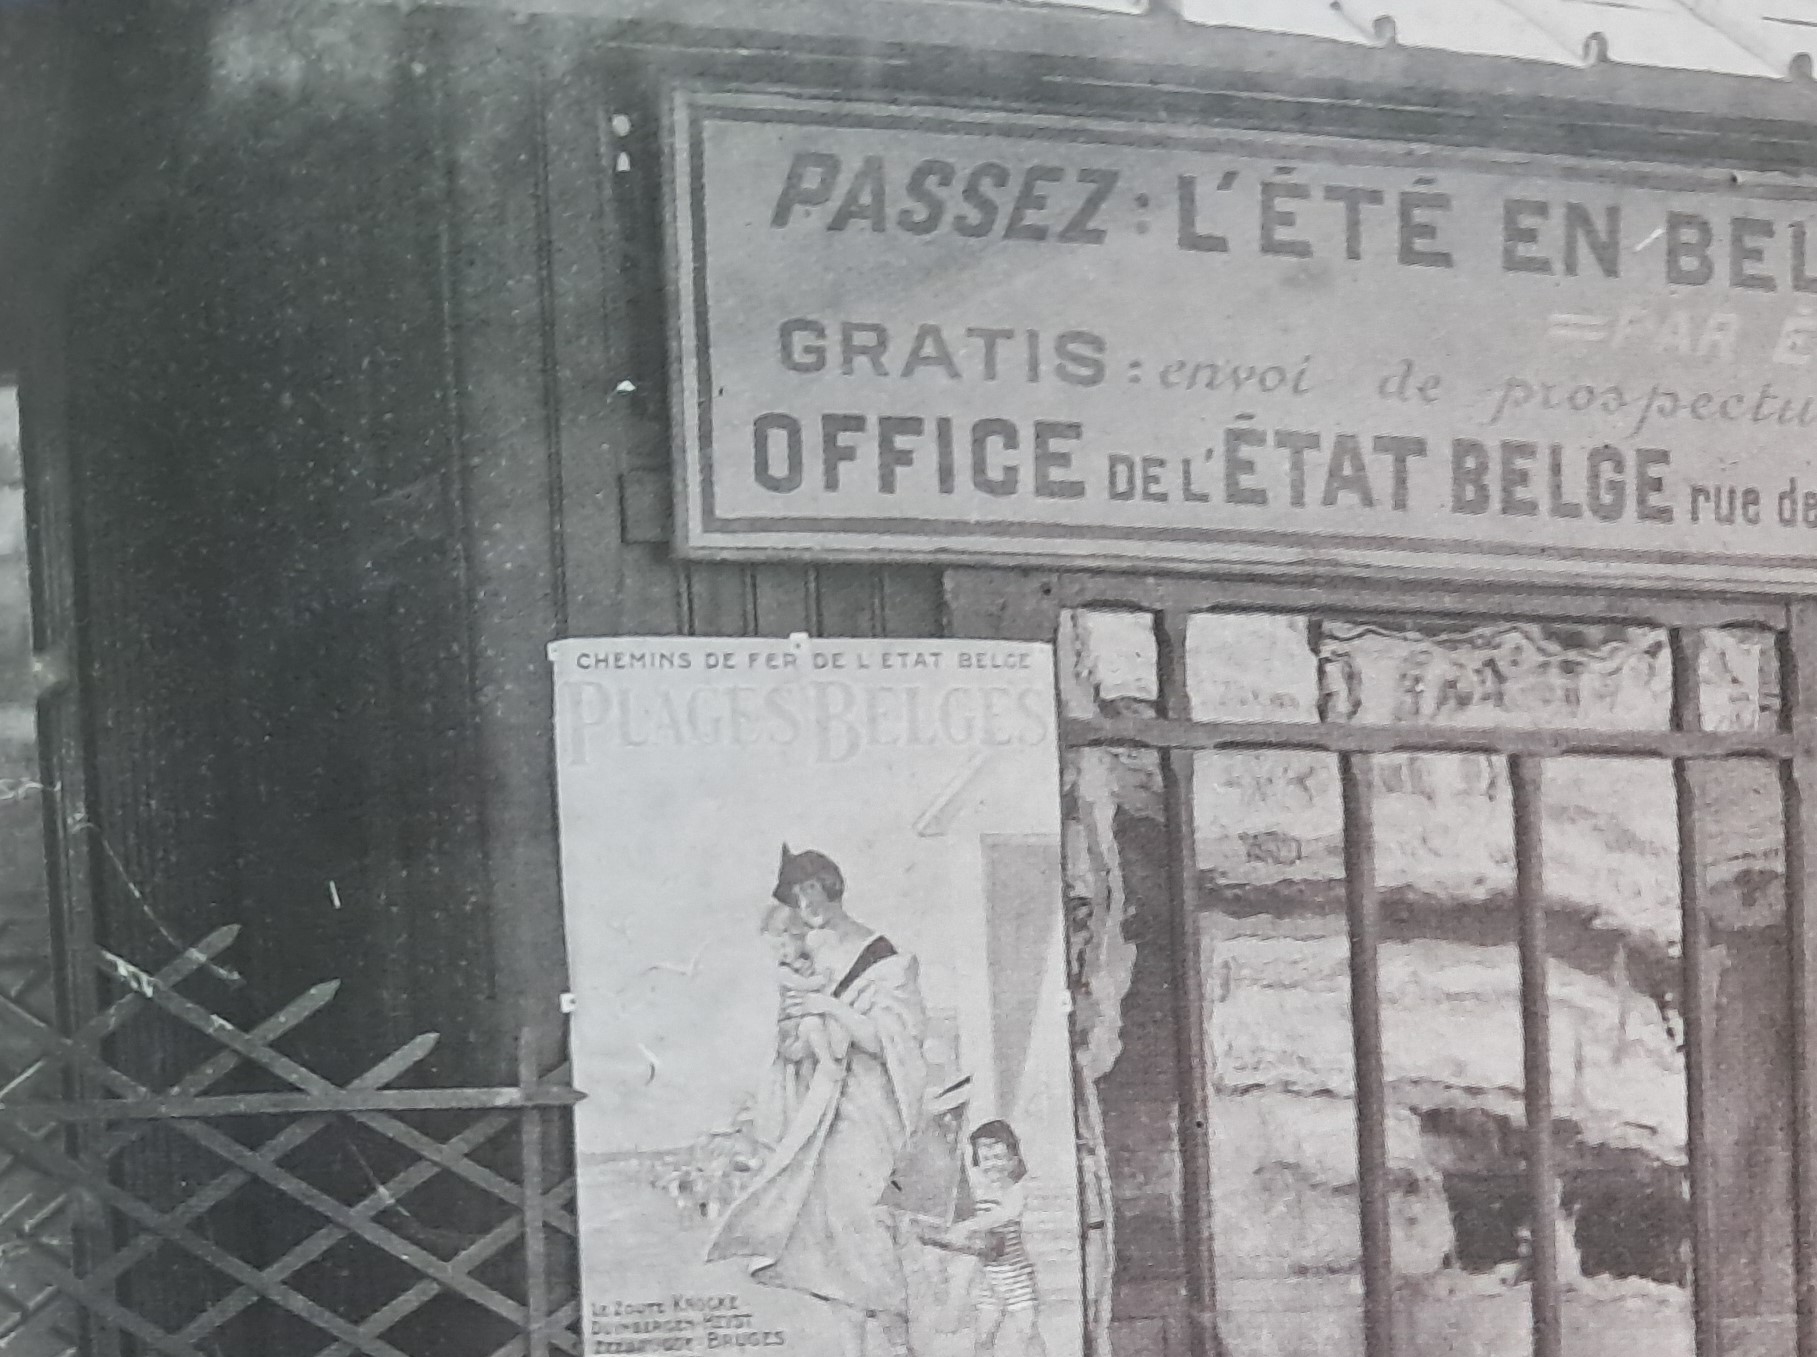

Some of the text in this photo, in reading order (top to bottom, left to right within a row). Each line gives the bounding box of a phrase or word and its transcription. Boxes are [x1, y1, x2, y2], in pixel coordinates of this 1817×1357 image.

[1177, 165, 1456, 270] L'ÉTÉ
[1501, 197, 1622, 280] EN
[1158, 353, 1312, 397] envoi
[1378, 359, 1443, 404] de
[752, 410, 1087, 501] OFFICE
[1107, 451, 1169, 503] DE
[1182, 412, 1428, 513] L'ÉTAT
[1450, 435, 1673, 527] BELGE
[1689, 482, 1761, 528] rue
[575, 651, 693, 672] CHEMINS
[704, 651, 736, 671] DE
[747, 651, 798, 670] FER
[812, 652, 846, 670] DE
[958, 652, 1031, 669] BELGE
[560, 679, 1049, 768] PLAGES BELGES
